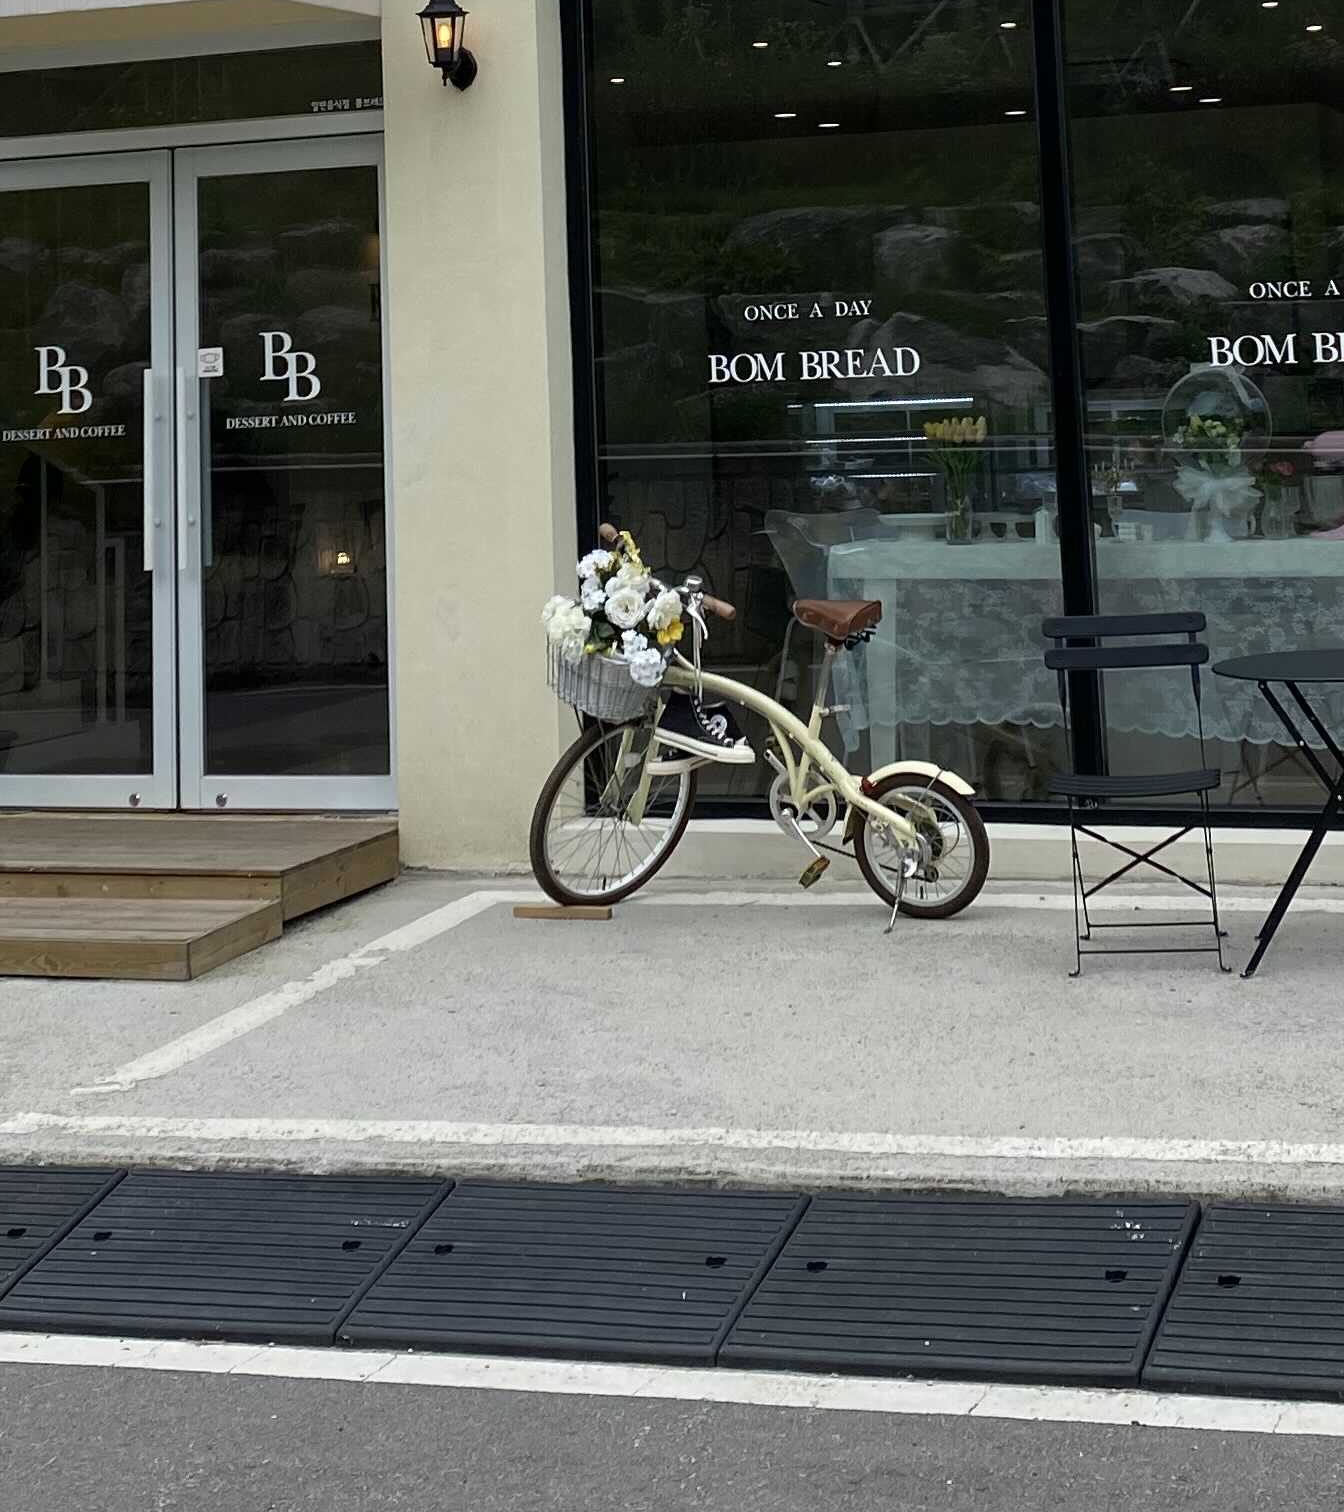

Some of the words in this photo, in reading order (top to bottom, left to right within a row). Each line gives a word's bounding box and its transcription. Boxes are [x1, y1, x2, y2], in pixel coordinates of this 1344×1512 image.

[1249, 280, 1313, 299] ONCE
[1324, 279, 1341, 296] A
[744, 303, 800, 321] ONCE
[809, 302, 824, 318] A
[835, 299, 873, 317] DAY
[1207, 333, 1299, 367] BOM
[258, 331, 322, 403] BB
[707, 352, 786, 383] BOM
[799, 346, 921, 381] BREAD
[33, 345, 94, 415] BB
[2, 428, 53, 442] DESSERT
[54, 427, 79, 439] AND
[80, 424, 126, 438] COFFEE
[226, 415, 279, 429] DESSERT
[280, 414, 307, 427] AND
[308, 412, 356, 426] COFFEE
